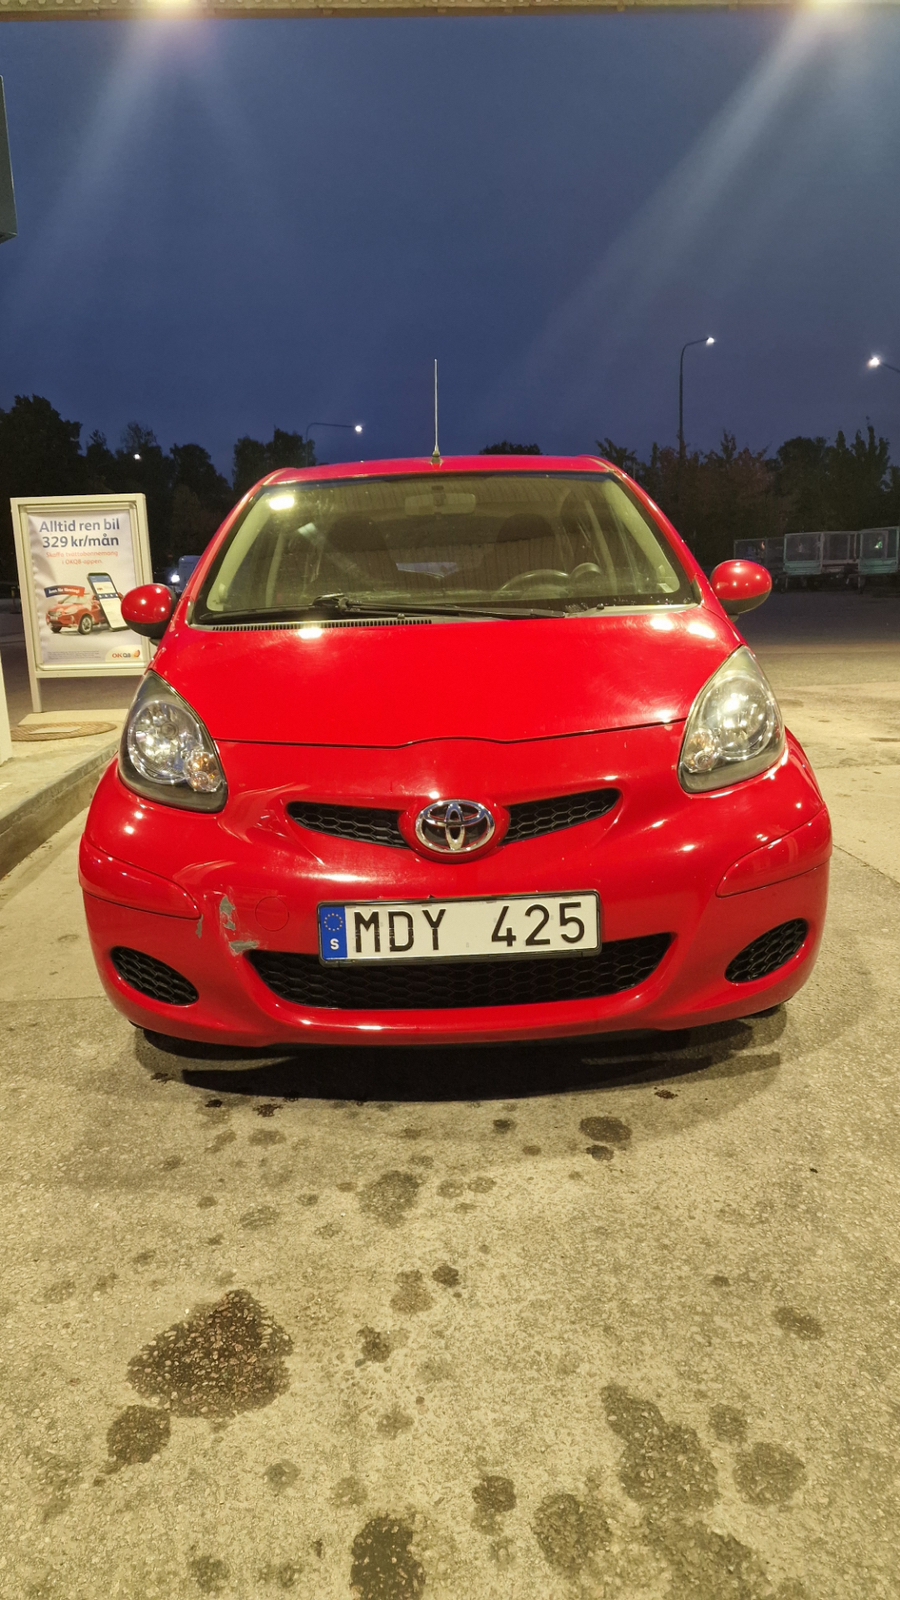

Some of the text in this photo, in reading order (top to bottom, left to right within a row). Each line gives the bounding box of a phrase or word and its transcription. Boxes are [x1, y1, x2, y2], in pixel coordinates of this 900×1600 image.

[39, 518, 120, 532] Alltid ren bil
[42, 533, 119, 548] 329 kr/mån
[354, 901, 585, 952] MDY 425
[330, 938, 339, 950] S
